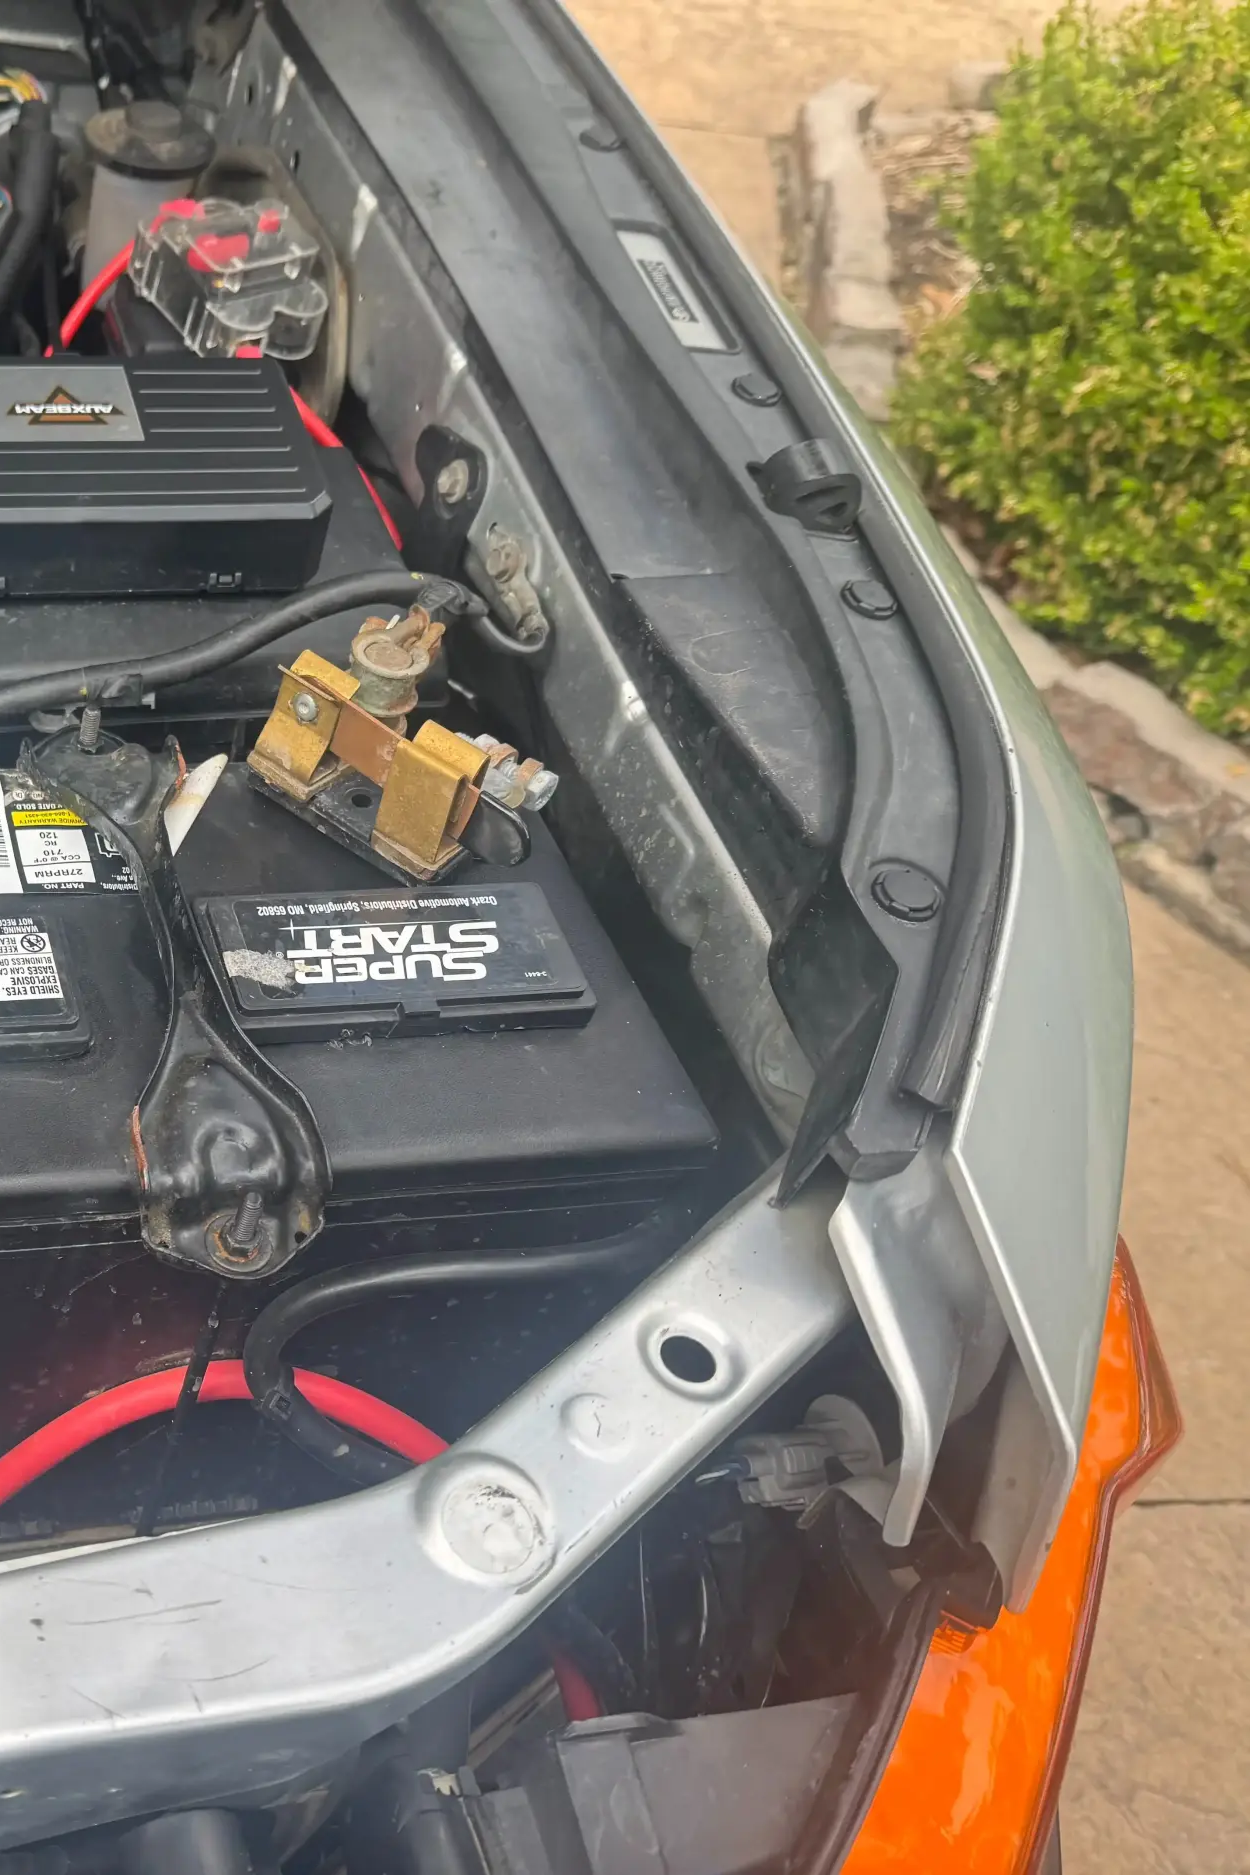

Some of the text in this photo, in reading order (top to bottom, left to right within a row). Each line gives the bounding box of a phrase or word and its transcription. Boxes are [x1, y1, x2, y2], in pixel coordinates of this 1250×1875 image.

[14, 402, 114, 415] AUXBEAM
[34, 868, 84, 878] 27RPRM
[256, 895, 498, 916] Ozark Automotive Distributors, Springfield, MO 65802
[17, 918, 34, 926] NOT
[286, 920, 500, 960] START
[10, 956, 53, 966] BLINDNESS
[9, 966, 26, 975] CAN
[27, 965, 55, 975] GASES
[294, 950, 487, 984] SUPER
[10, 975, 57, 986] EXPLOSIVE
[1, 985, 60, 996] SHIELD EYES.
